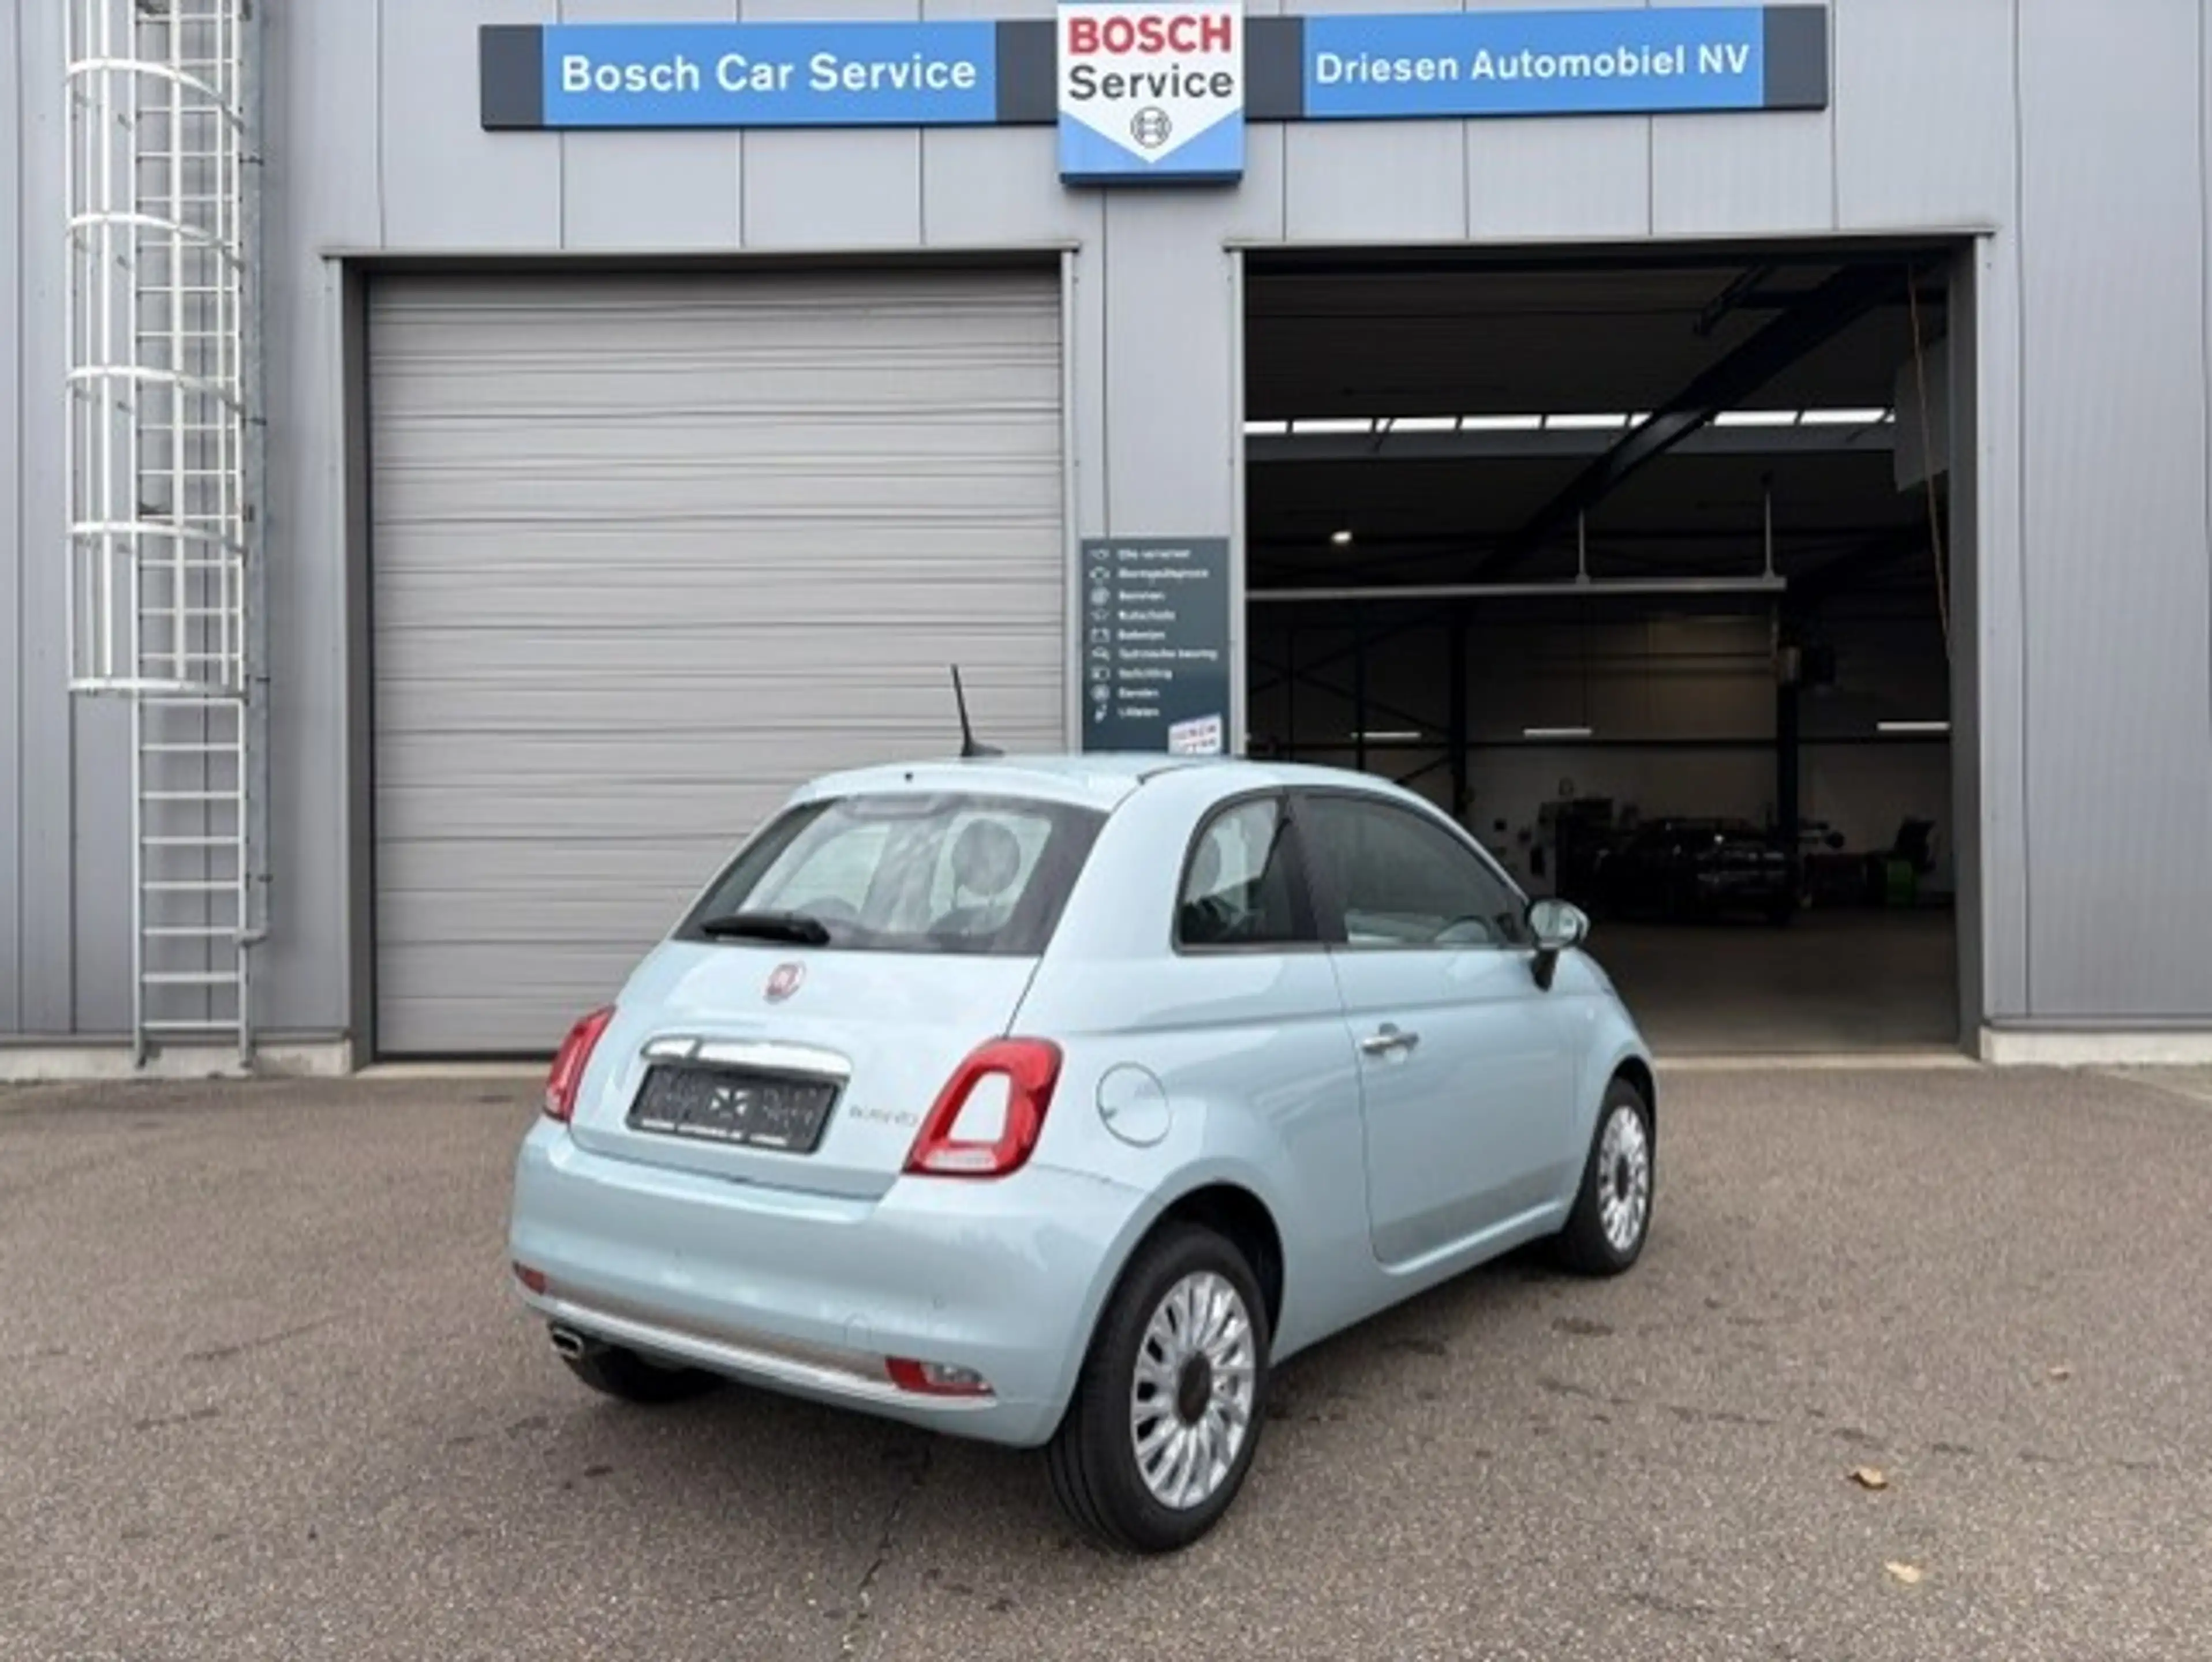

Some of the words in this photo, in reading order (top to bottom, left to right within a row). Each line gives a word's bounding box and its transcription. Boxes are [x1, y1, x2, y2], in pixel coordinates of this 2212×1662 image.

[1068, 14, 1232, 55] BOSCH
[562, 55, 700, 92] Bosch
[716, 53, 794, 92] Car
[809, 53, 977, 91] Service
[1068, 63, 1234, 101] Service
[1316, 53, 1458, 83] Driesen
[1471, 46, 1685, 79] Automobiel
[1699, 44, 1750, 74] NV
